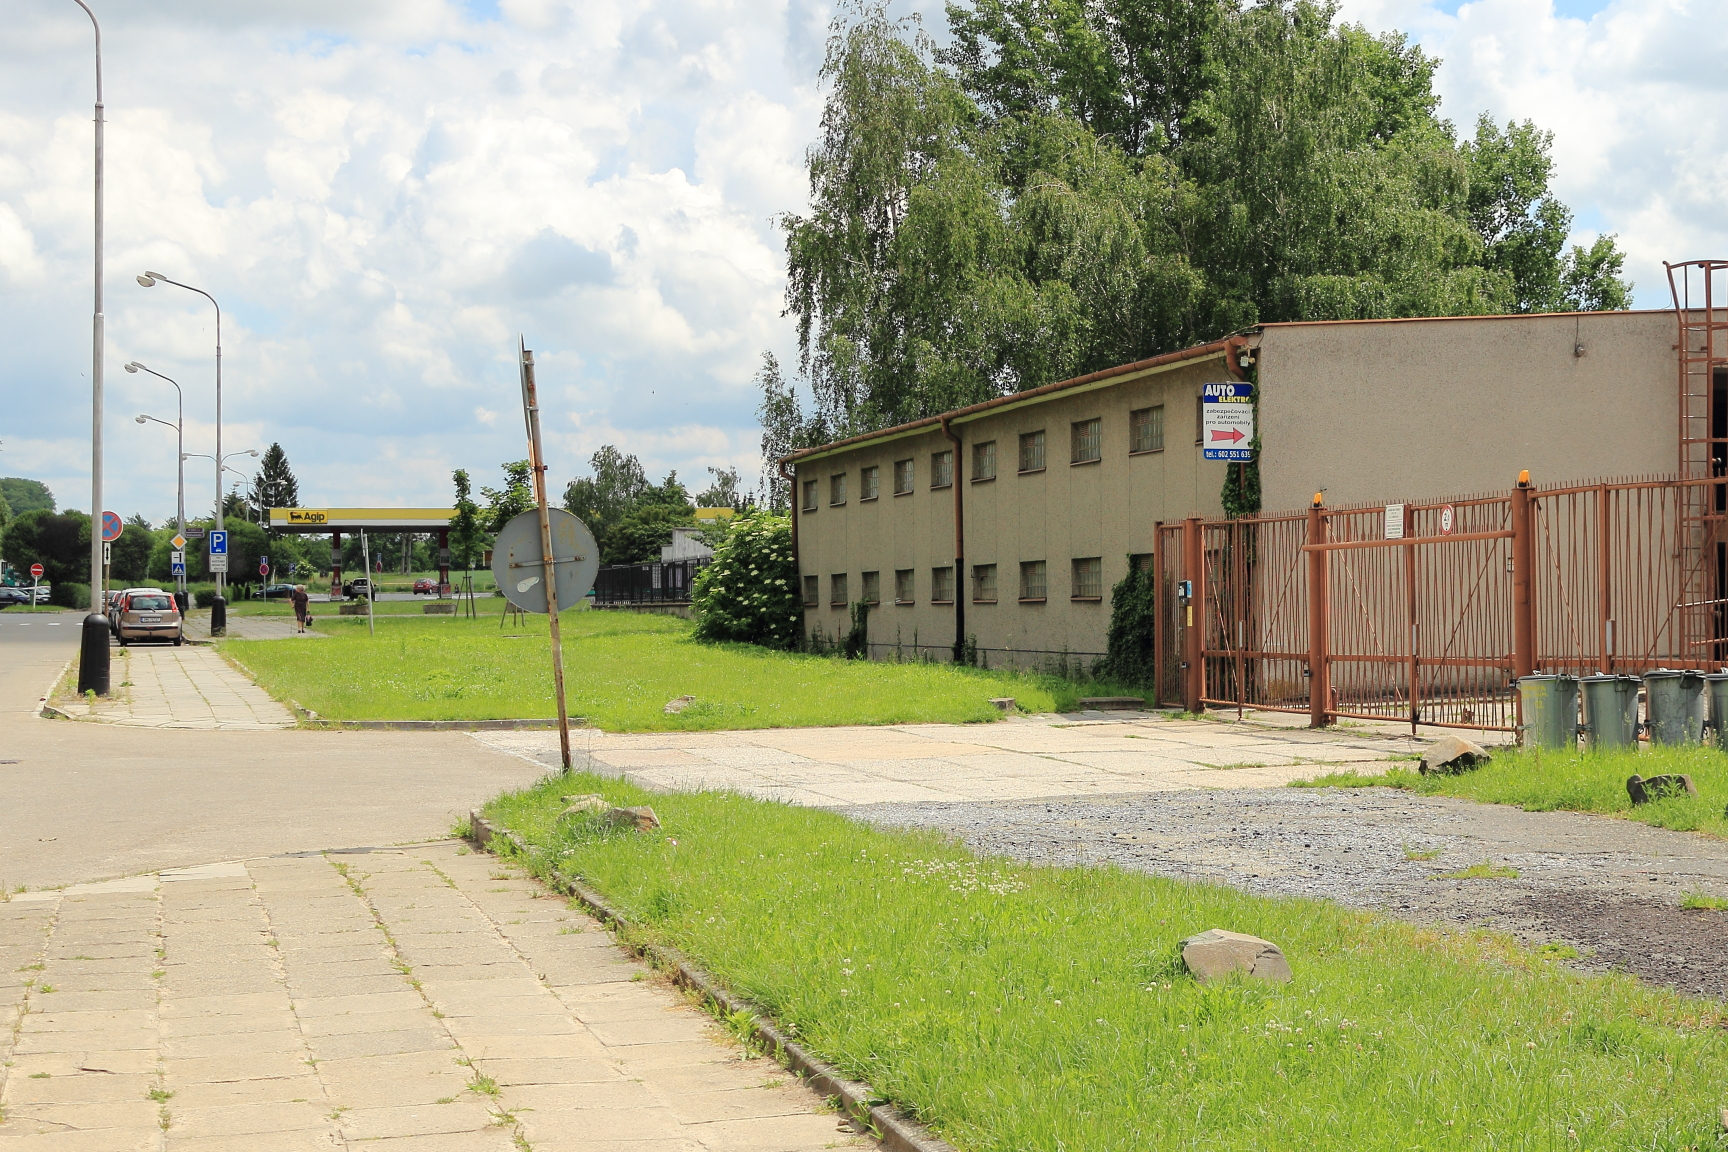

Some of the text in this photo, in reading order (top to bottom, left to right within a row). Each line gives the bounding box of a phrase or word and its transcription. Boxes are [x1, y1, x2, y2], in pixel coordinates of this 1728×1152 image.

[1205, 385, 1235, 396] AUTO
[303, 511, 325, 523] Agip
[213, 533, 224, 548] P
